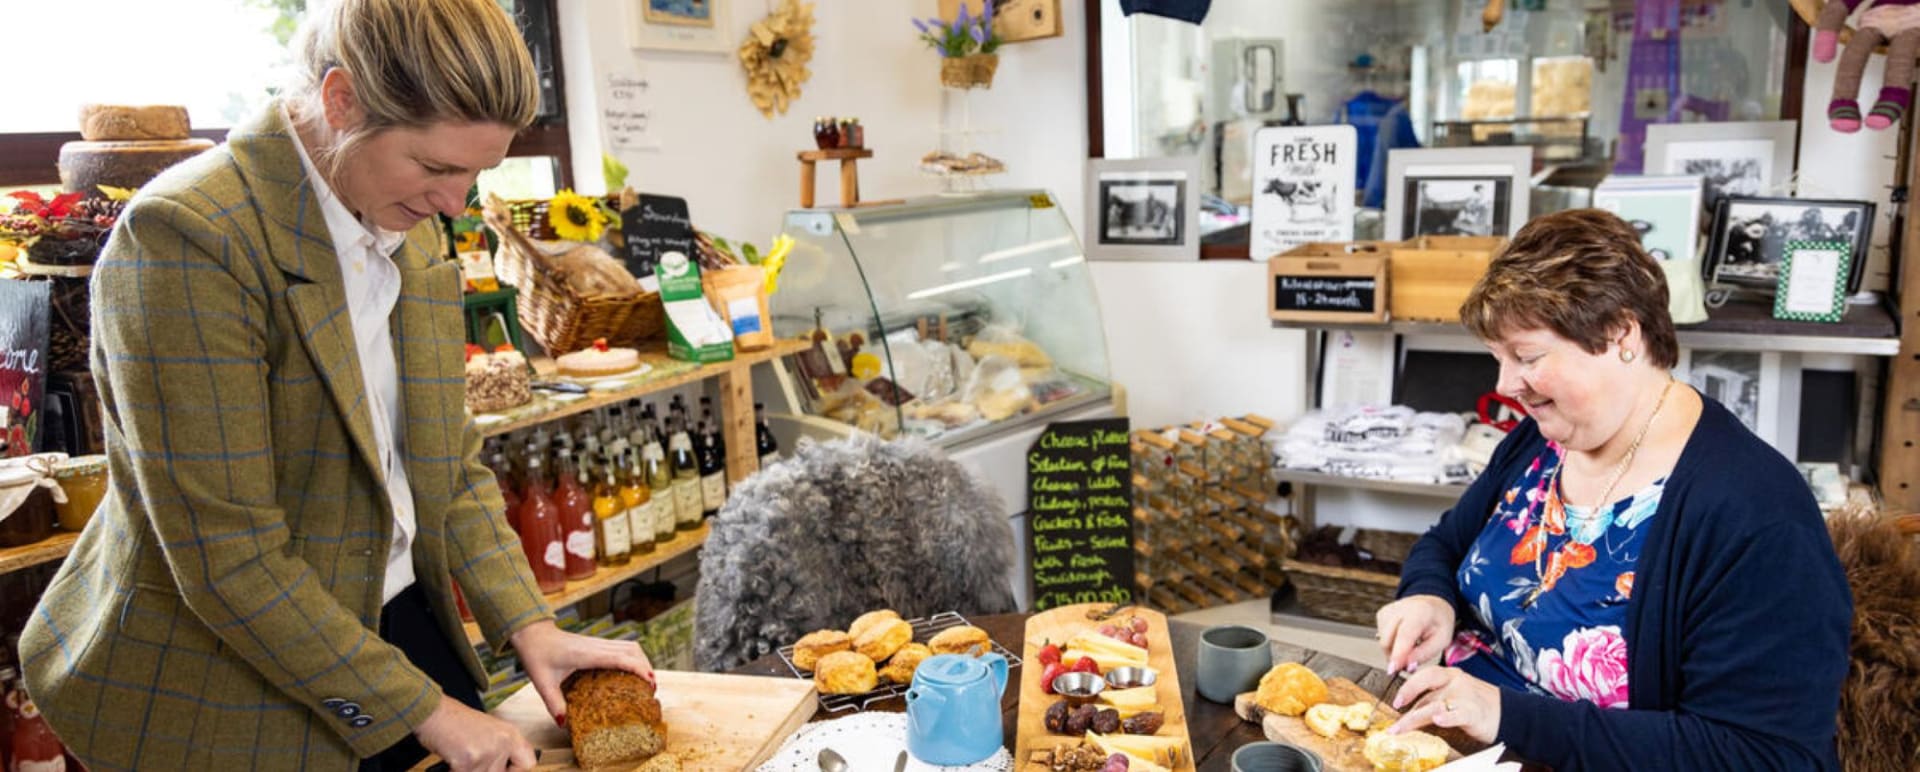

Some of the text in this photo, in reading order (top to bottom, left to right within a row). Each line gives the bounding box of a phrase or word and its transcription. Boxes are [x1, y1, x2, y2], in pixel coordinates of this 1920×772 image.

[1271, 143, 1337, 166] FRESH
[1040, 431, 1088, 449] Cheese
[1091, 455, 1106, 473] of
